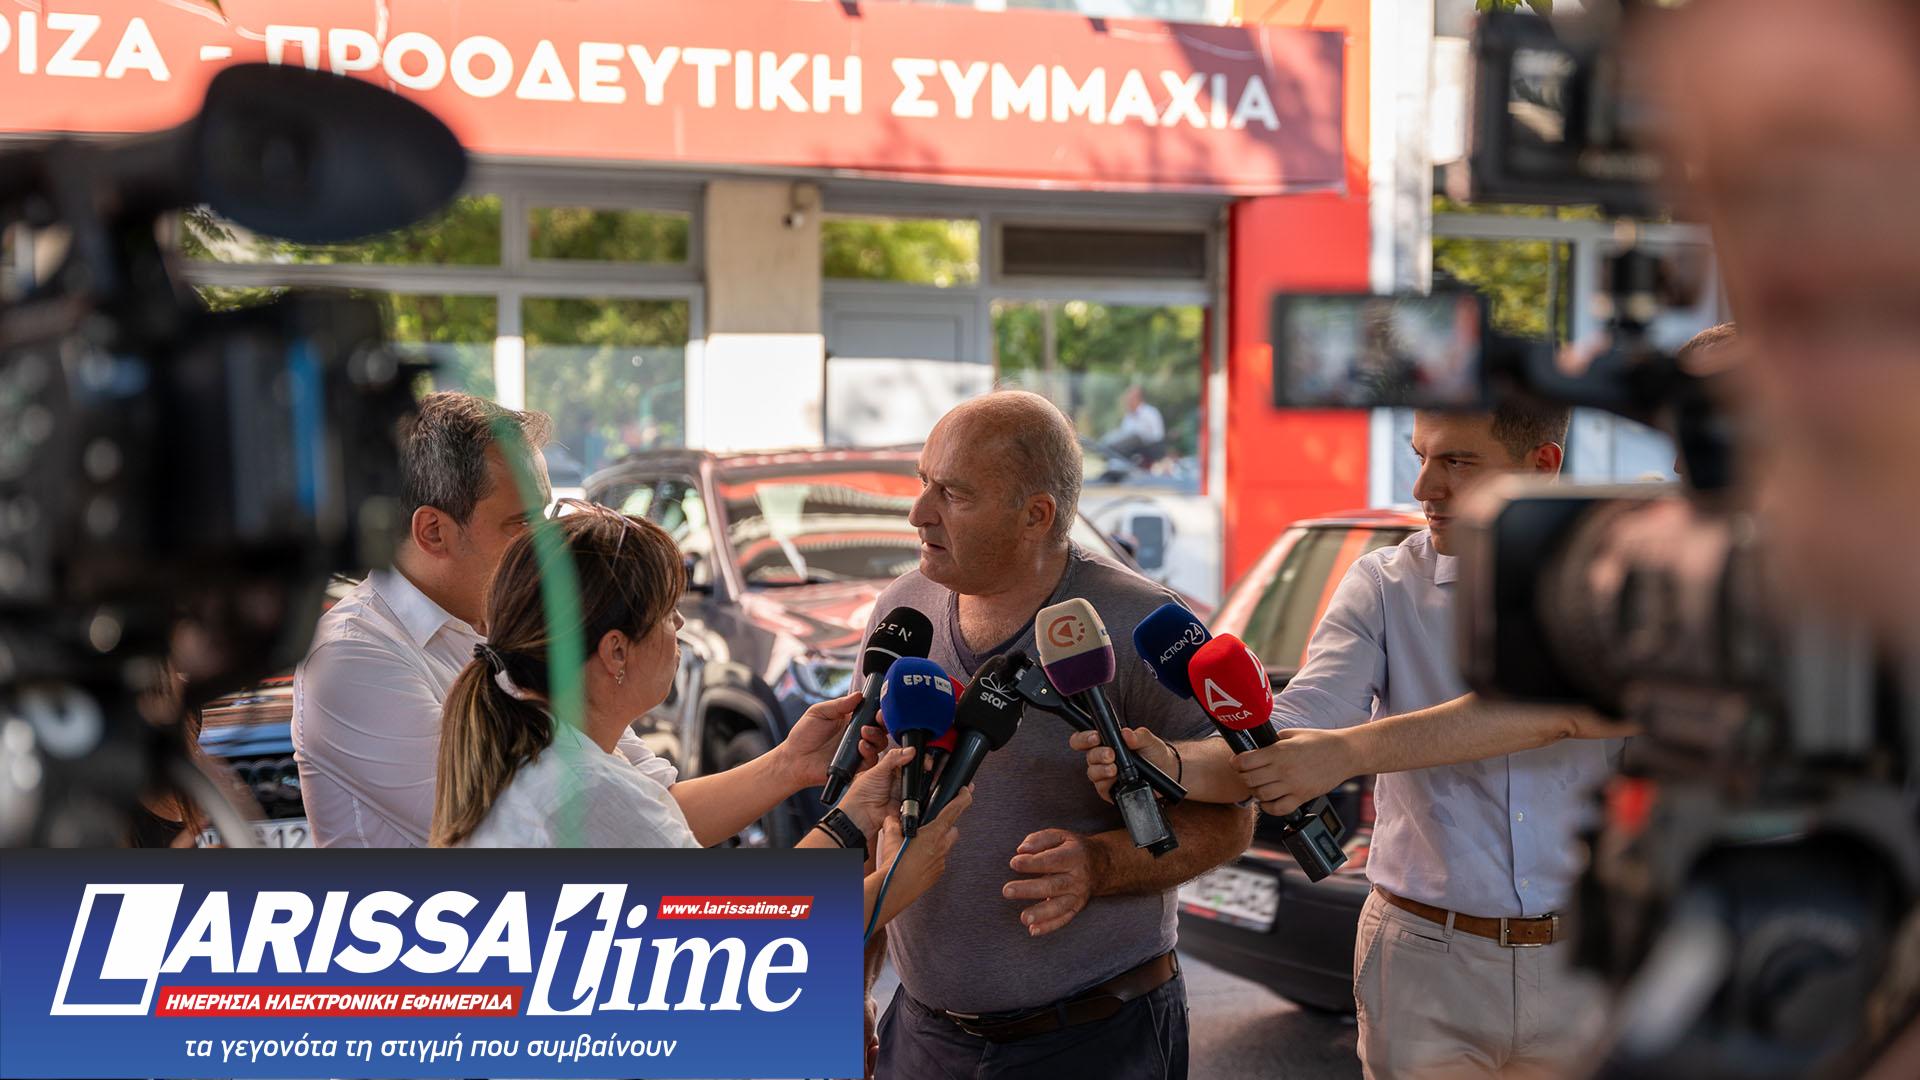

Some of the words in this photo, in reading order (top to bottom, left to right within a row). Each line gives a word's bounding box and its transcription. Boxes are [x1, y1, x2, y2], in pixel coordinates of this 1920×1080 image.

[0, 11, 170, 81] ΙΖΑ
[265, 24, 862, 114] ΠΡΟΟΔΕΥΤΙΚΗ
[890, 57, 1280, 130] ΣΥΜΜΑΧΙΑ
[1160, 634, 1188, 664] ACTION
[979, 690, 1008, 711] star
